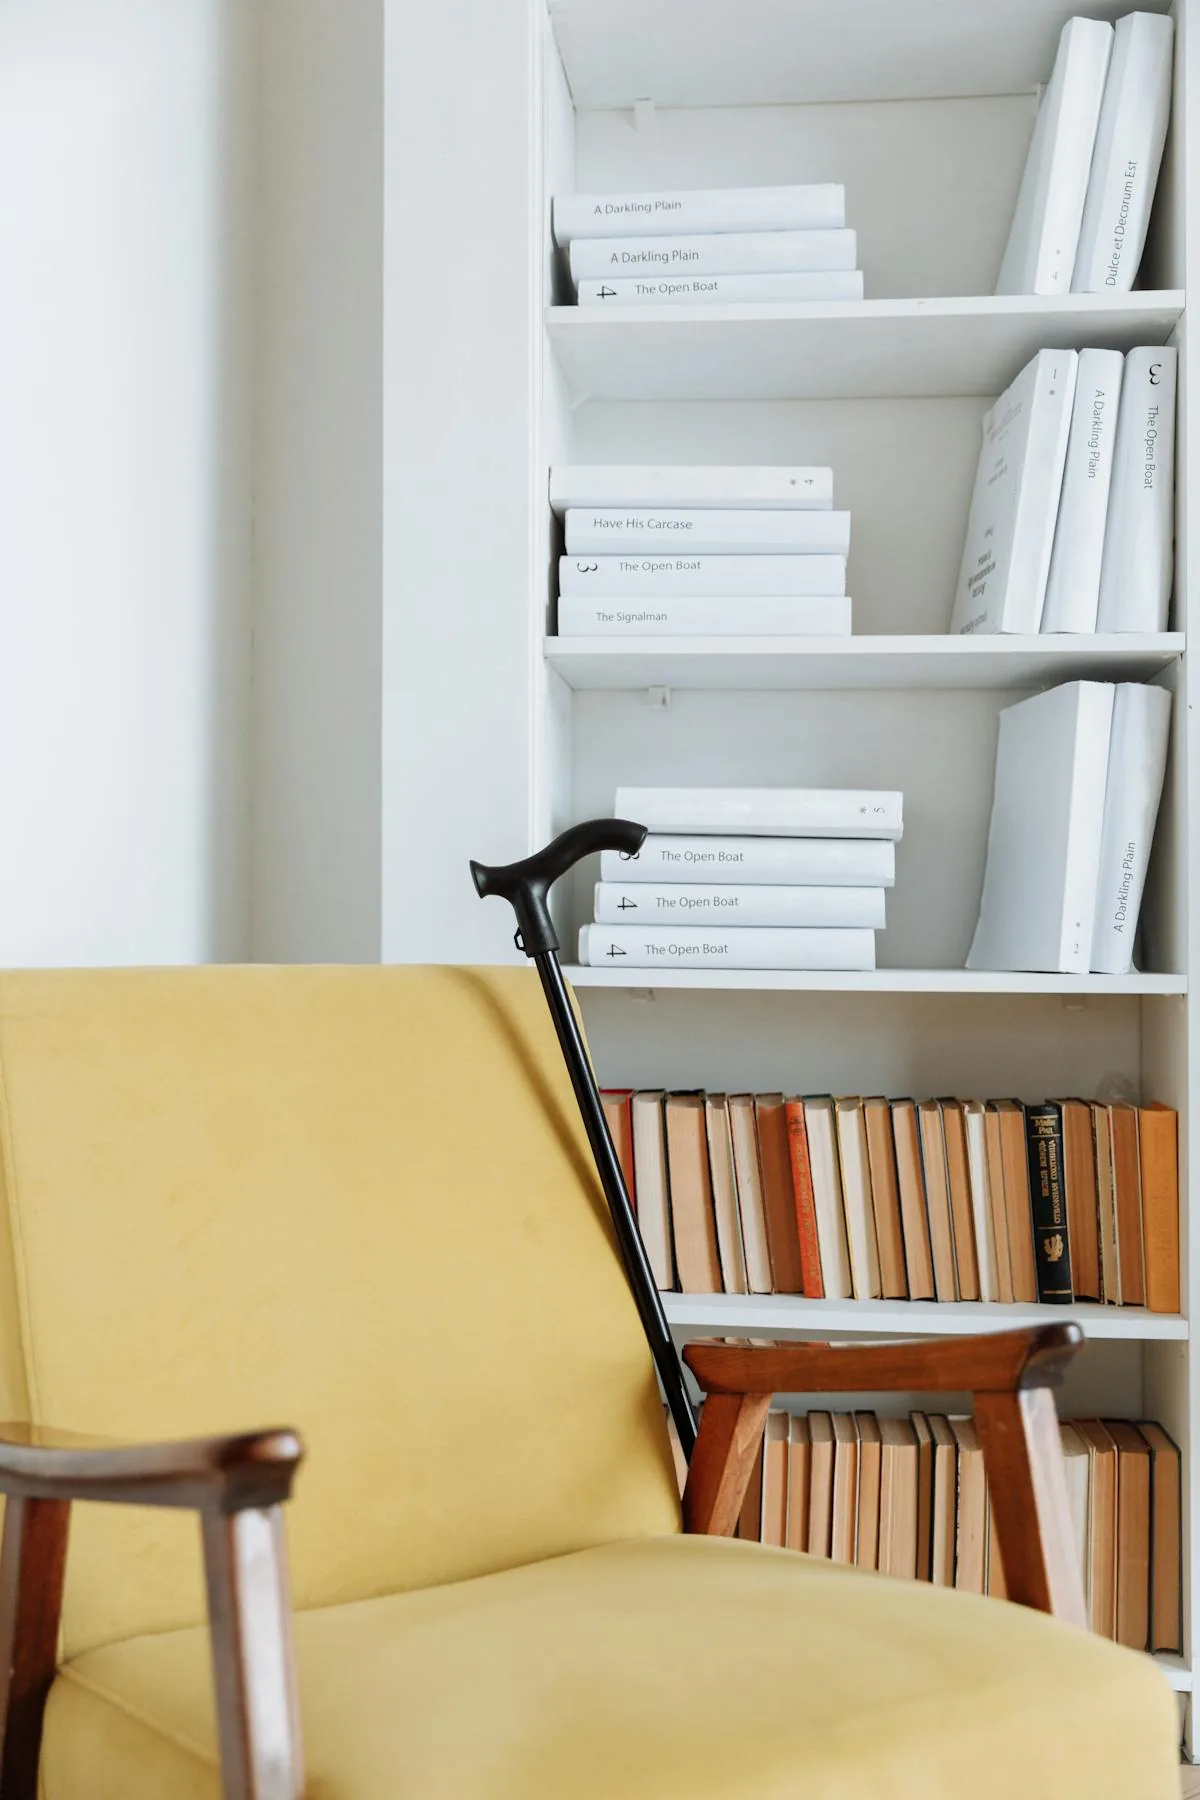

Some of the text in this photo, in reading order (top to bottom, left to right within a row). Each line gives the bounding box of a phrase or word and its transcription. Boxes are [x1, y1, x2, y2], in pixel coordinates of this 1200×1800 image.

[593, 199, 683, 215] A Darkling Plain
[1104, 159, 1139, 287] Dulce et Decorum Est
[610, 248, 700, 265] A Darkling Plain
[596, 285, 618, 300] 4
[634, 280, 719, 296] The Open Boat
[1148, 362, 1163, 386] 3
[1087, 388, 1106, 479] A Darkling Plain
[1142, 404, 1159, 490] The Open Boat
[592, 517, 693, 530] Have His Carcase
[576, 561, 599, 573] 3
[619, 559, 702, 574] The Open Boat
[595, 610, 668, 624] The Signalman
[660, 850, 744, 864] The Open Boat
[1113, 841, 1137, 933] A Darkling Plain
[616, 896, 639, 911] 4
[655, 895, 740, 910] The Open Boat
[605, 943, 628, 958] 4
[644, 942, 729, 957] The Open Boat
